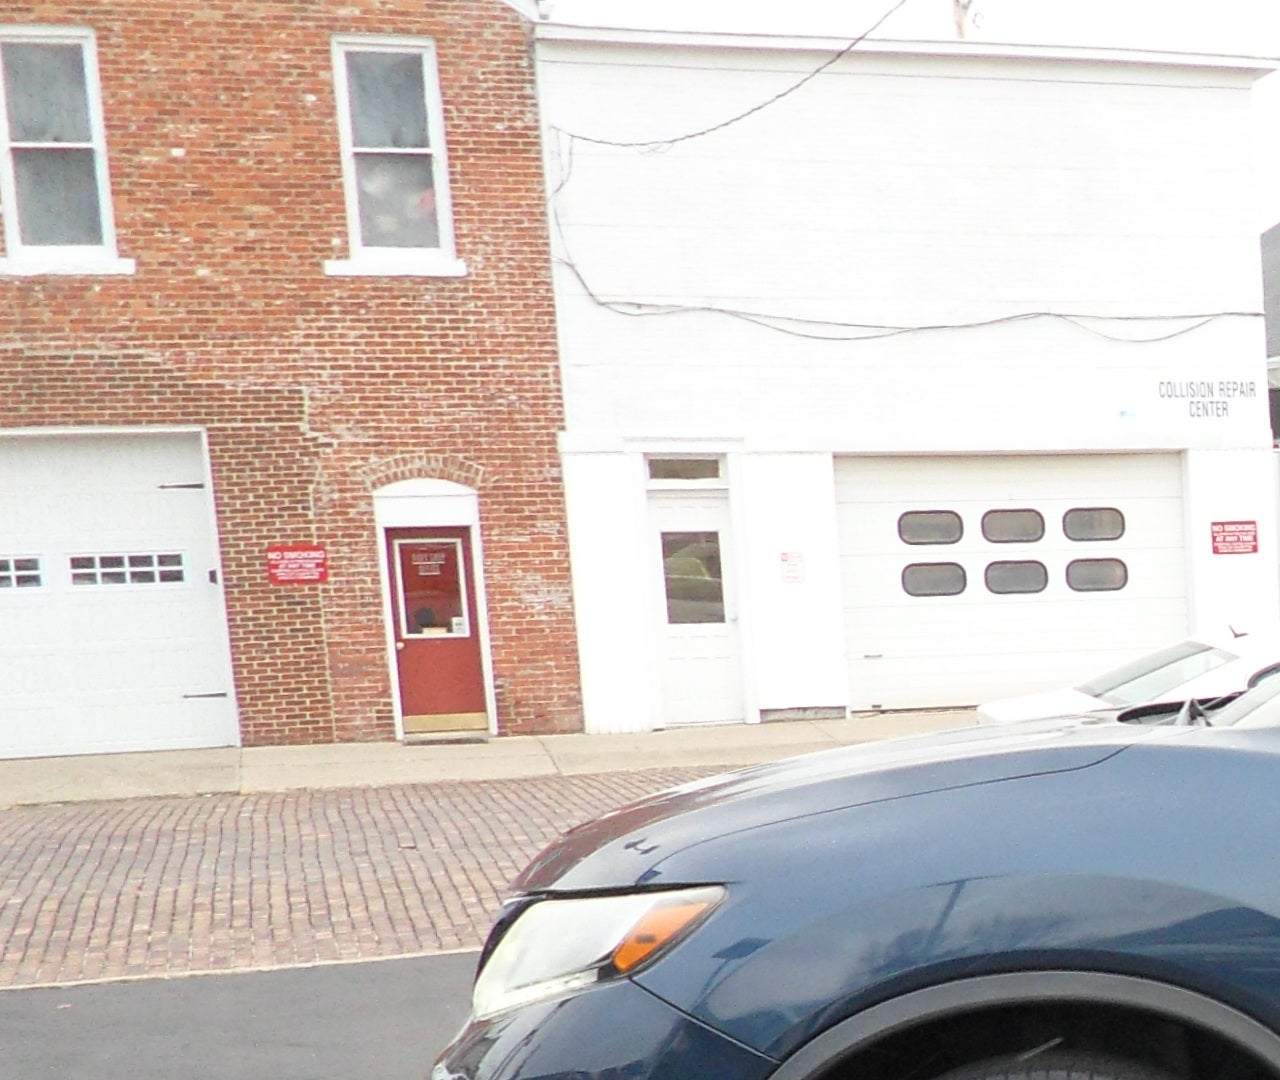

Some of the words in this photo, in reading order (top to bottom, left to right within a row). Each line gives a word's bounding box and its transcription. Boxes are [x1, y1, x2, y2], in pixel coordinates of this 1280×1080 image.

[1158, 381, 1214, 398] COLLISION
[1218, 381, 1256, 398] REPAIR
[1189, 401, 1229, 417] CENTER
[267, 551, 281, 559] NO
